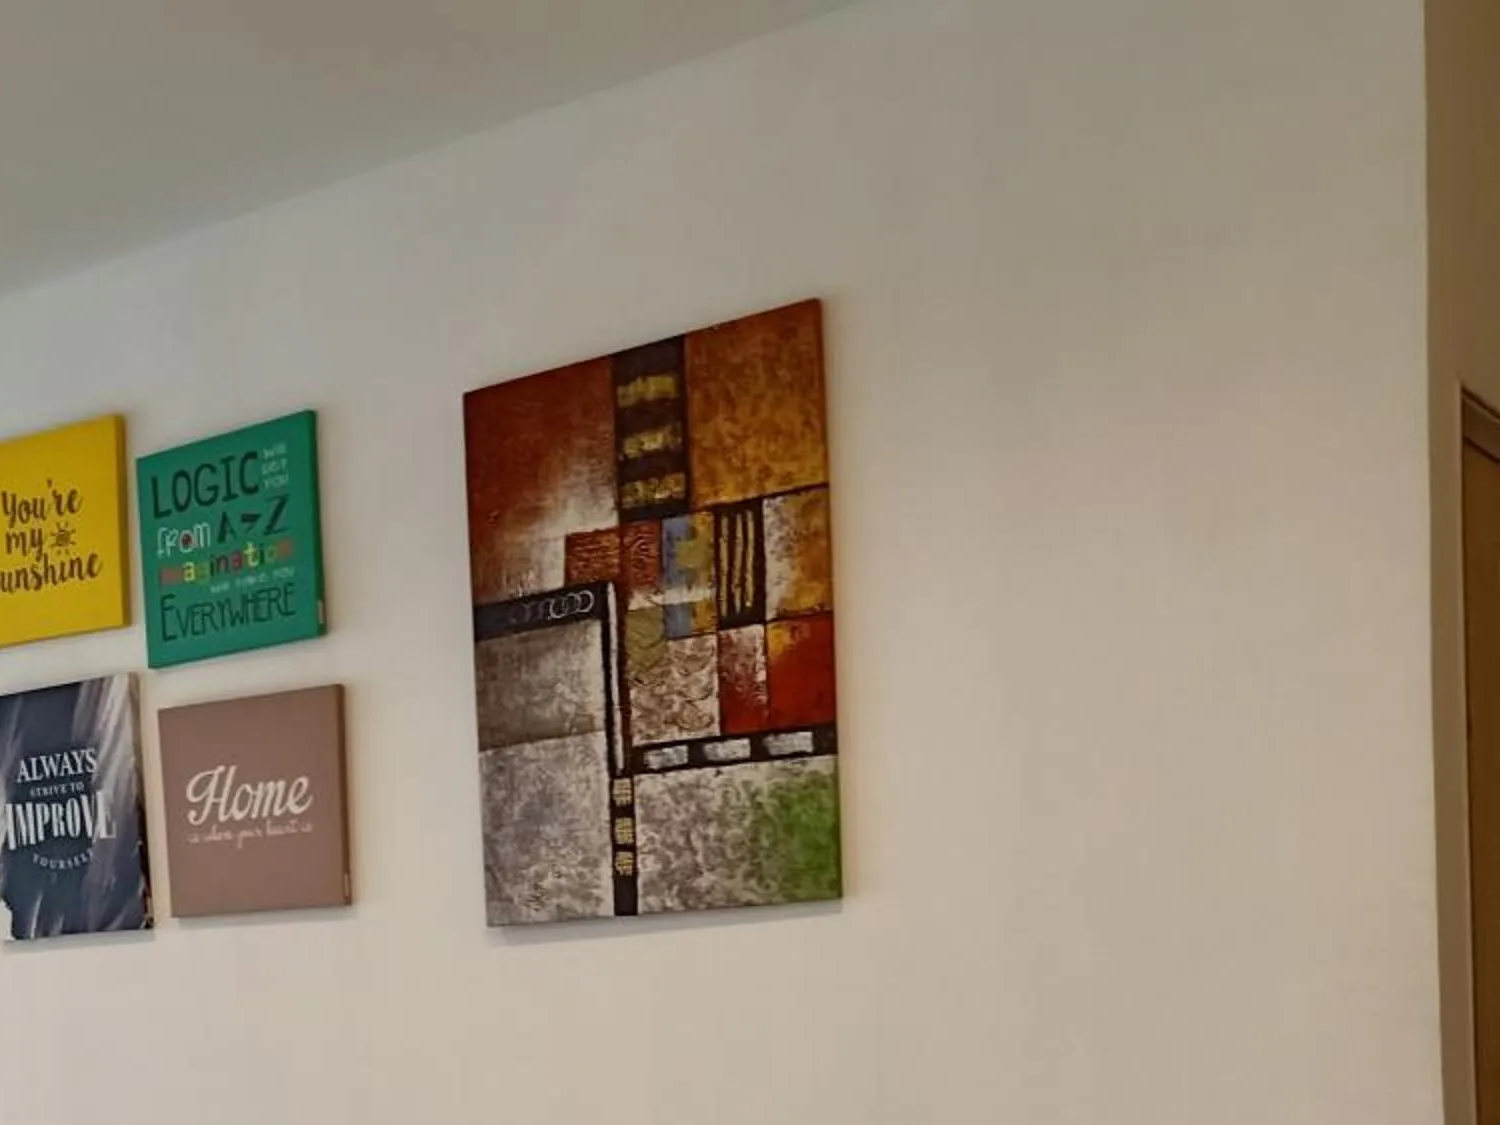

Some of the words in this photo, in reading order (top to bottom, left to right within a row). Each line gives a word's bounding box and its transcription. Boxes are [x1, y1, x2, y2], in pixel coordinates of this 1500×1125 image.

[2, 478, 84, 528] You're
[152, 451, 259, 519] LOGIC
[7, 527, 43, 562] my
[161, 581, 298, 643] EVERYWHERE
[18, 748, 97, 783] ALWAYS
[187, 765, 313, 825] Home
[5, 789, 117, 851] IMPROVE
